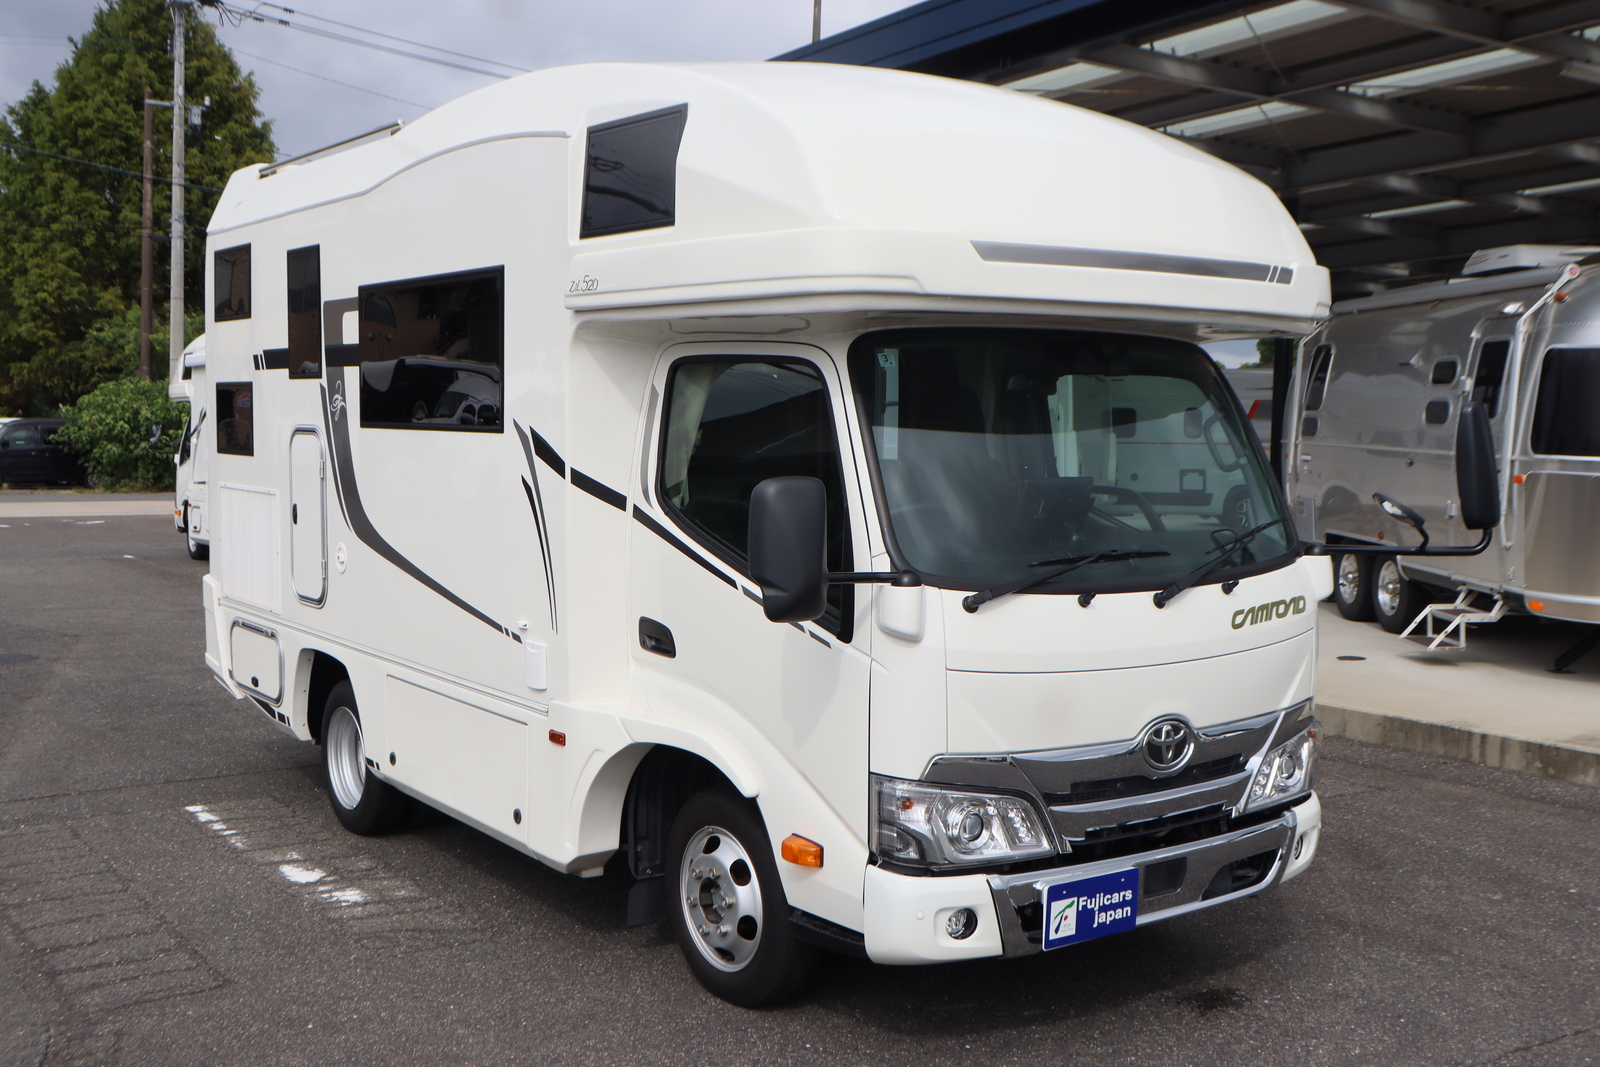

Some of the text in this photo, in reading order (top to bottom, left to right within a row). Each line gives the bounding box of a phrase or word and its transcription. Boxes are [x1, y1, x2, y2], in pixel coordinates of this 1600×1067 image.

[581, 275, 598, 291] 520
[882, 354, 889, 362] 3
[1231, 595, 1306, 629] CAMROAD
[1079, 890, 1132, 911] Fujicars
[1093, 906, 1131, 928] japan
